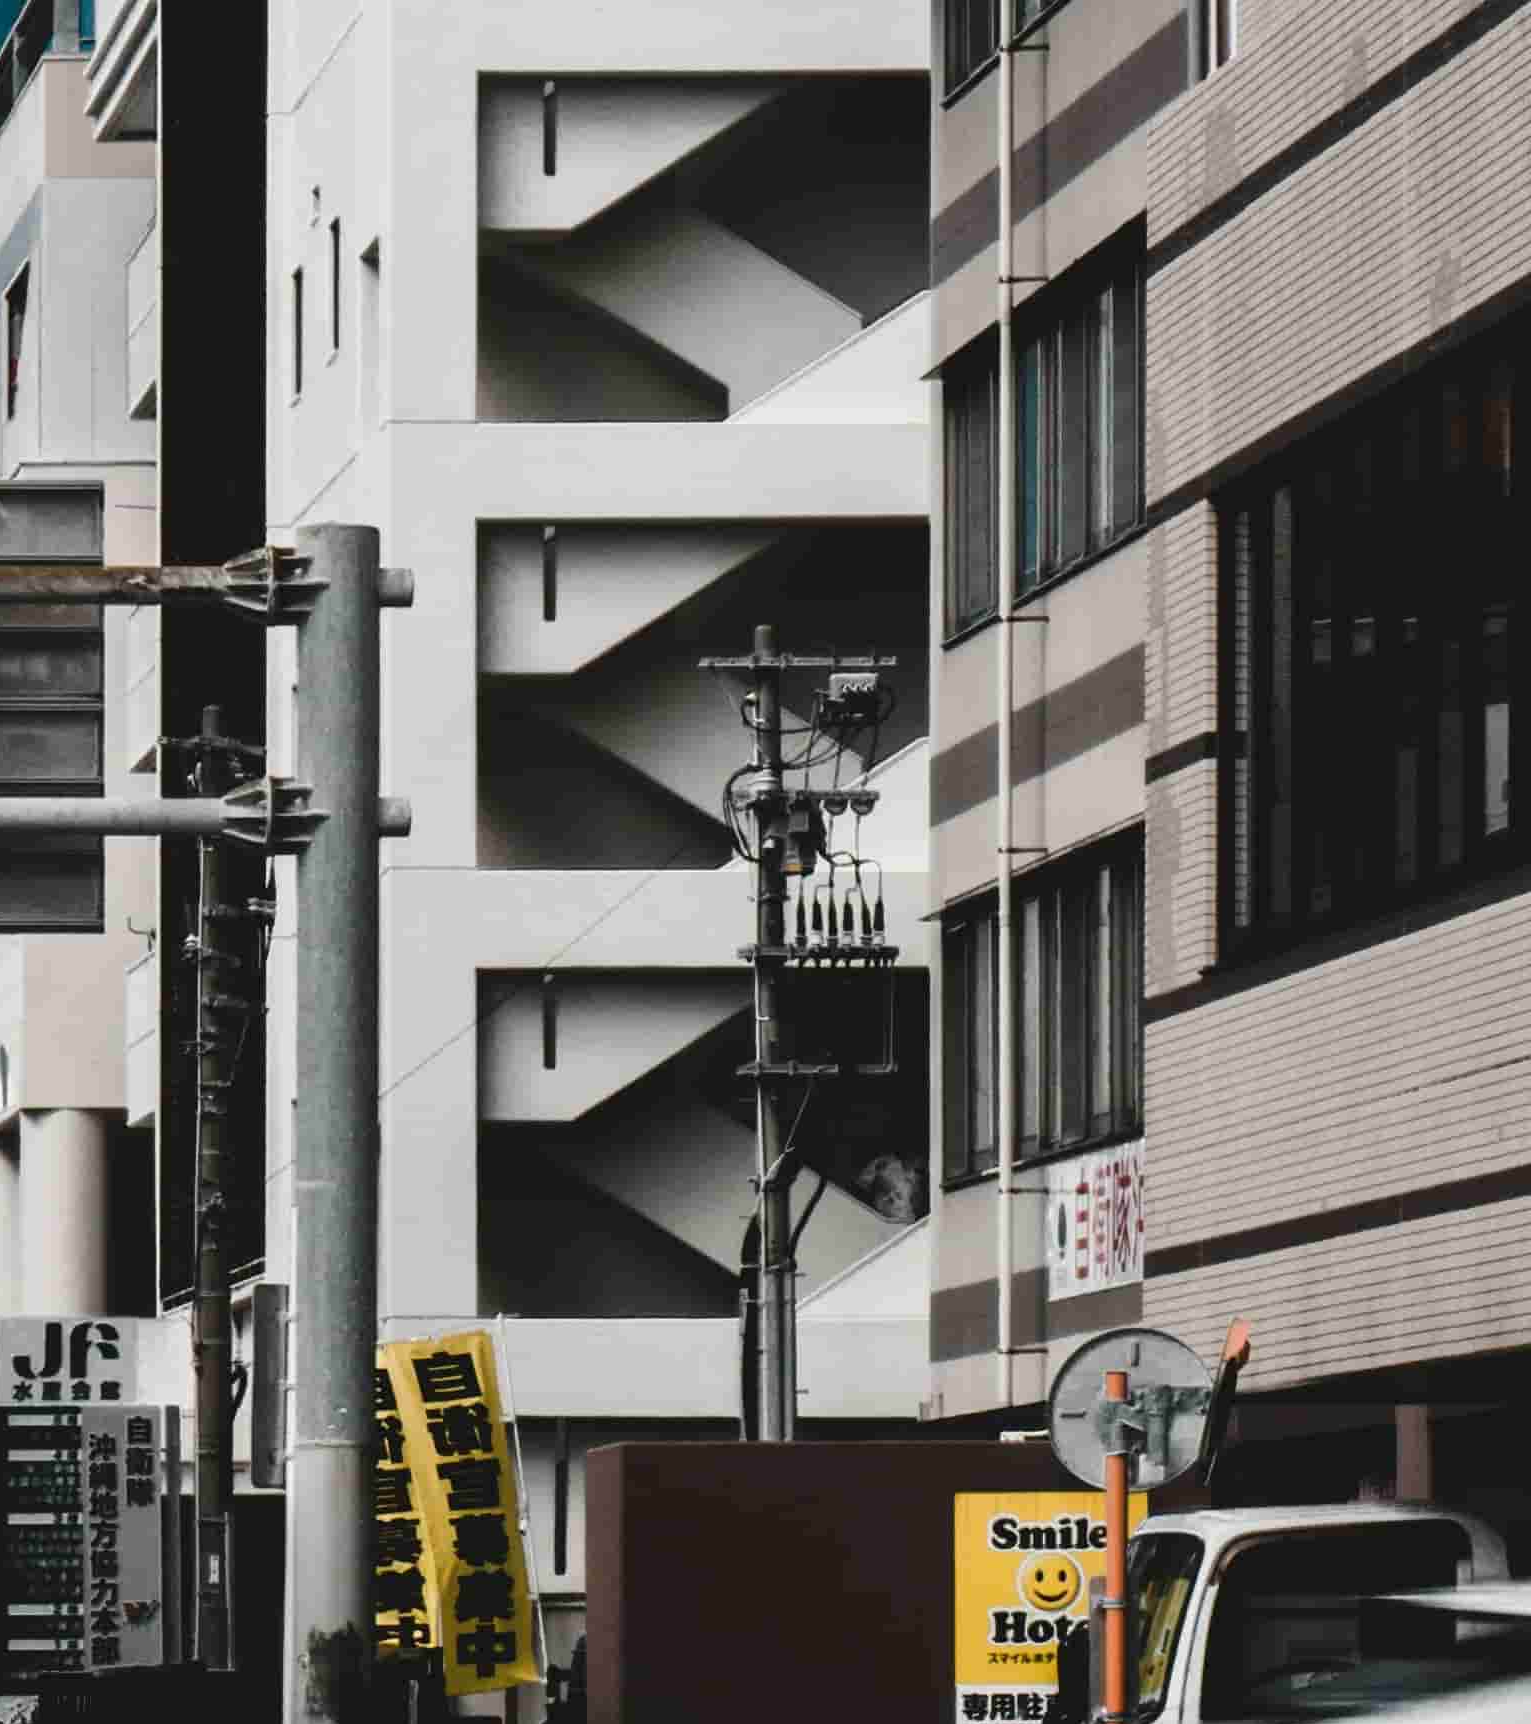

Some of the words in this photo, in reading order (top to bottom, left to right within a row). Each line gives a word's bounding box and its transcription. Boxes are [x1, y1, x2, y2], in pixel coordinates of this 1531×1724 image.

[991, 1517, 1107, 1550] Smile
[992, 1611, 1090, 1644] Hot
[988, 1652, 1056, 1665] スマイルホテ
[962, 1693, 1060, 1722] 専用駐
